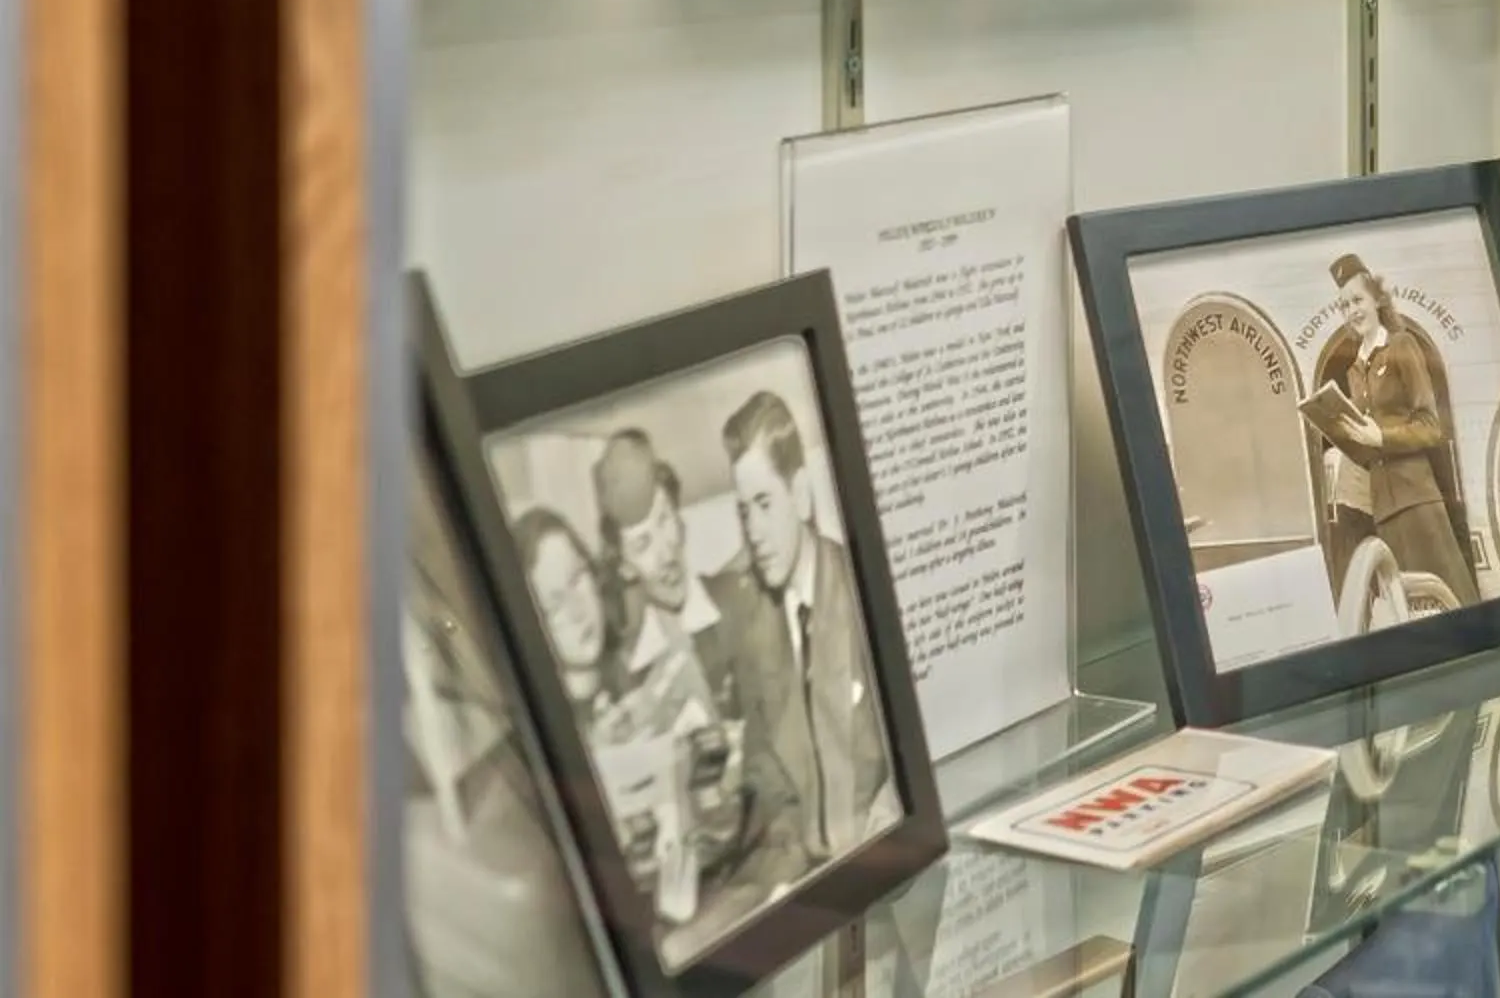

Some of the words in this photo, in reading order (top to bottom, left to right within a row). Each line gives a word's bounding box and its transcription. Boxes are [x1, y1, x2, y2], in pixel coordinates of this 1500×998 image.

[1171, 313, 1222, 404] NORTHWEST
[1229, 316, 1287, 395] AIRLINES
[1043, 777, 1187, 832] NWA
